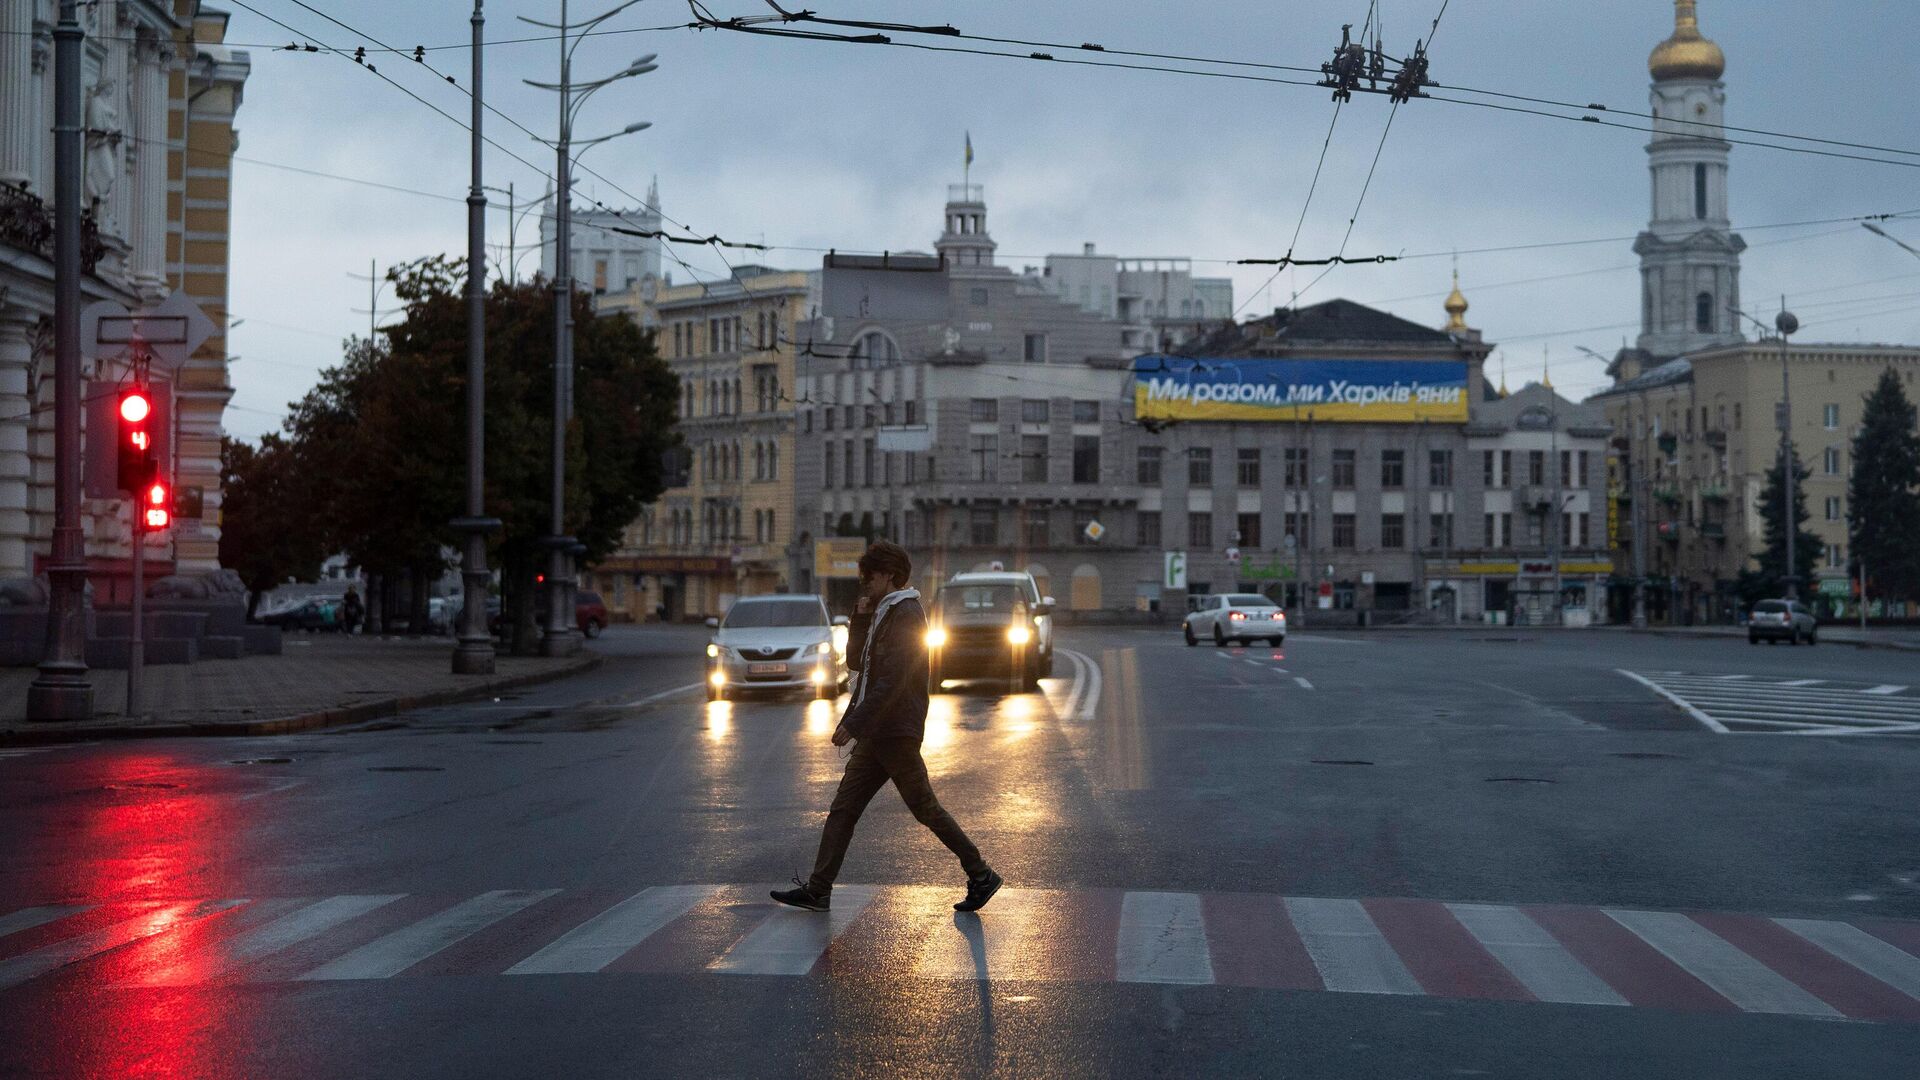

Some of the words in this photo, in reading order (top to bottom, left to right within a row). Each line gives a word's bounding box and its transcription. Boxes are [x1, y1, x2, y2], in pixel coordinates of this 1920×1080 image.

[1148, 377, 1189, 401] Ми
[1192, 382, 1280, 406] разом,
[1286, 384, 1324, 402] ми
[1326, 379, 1459, 407] Харків'яни
